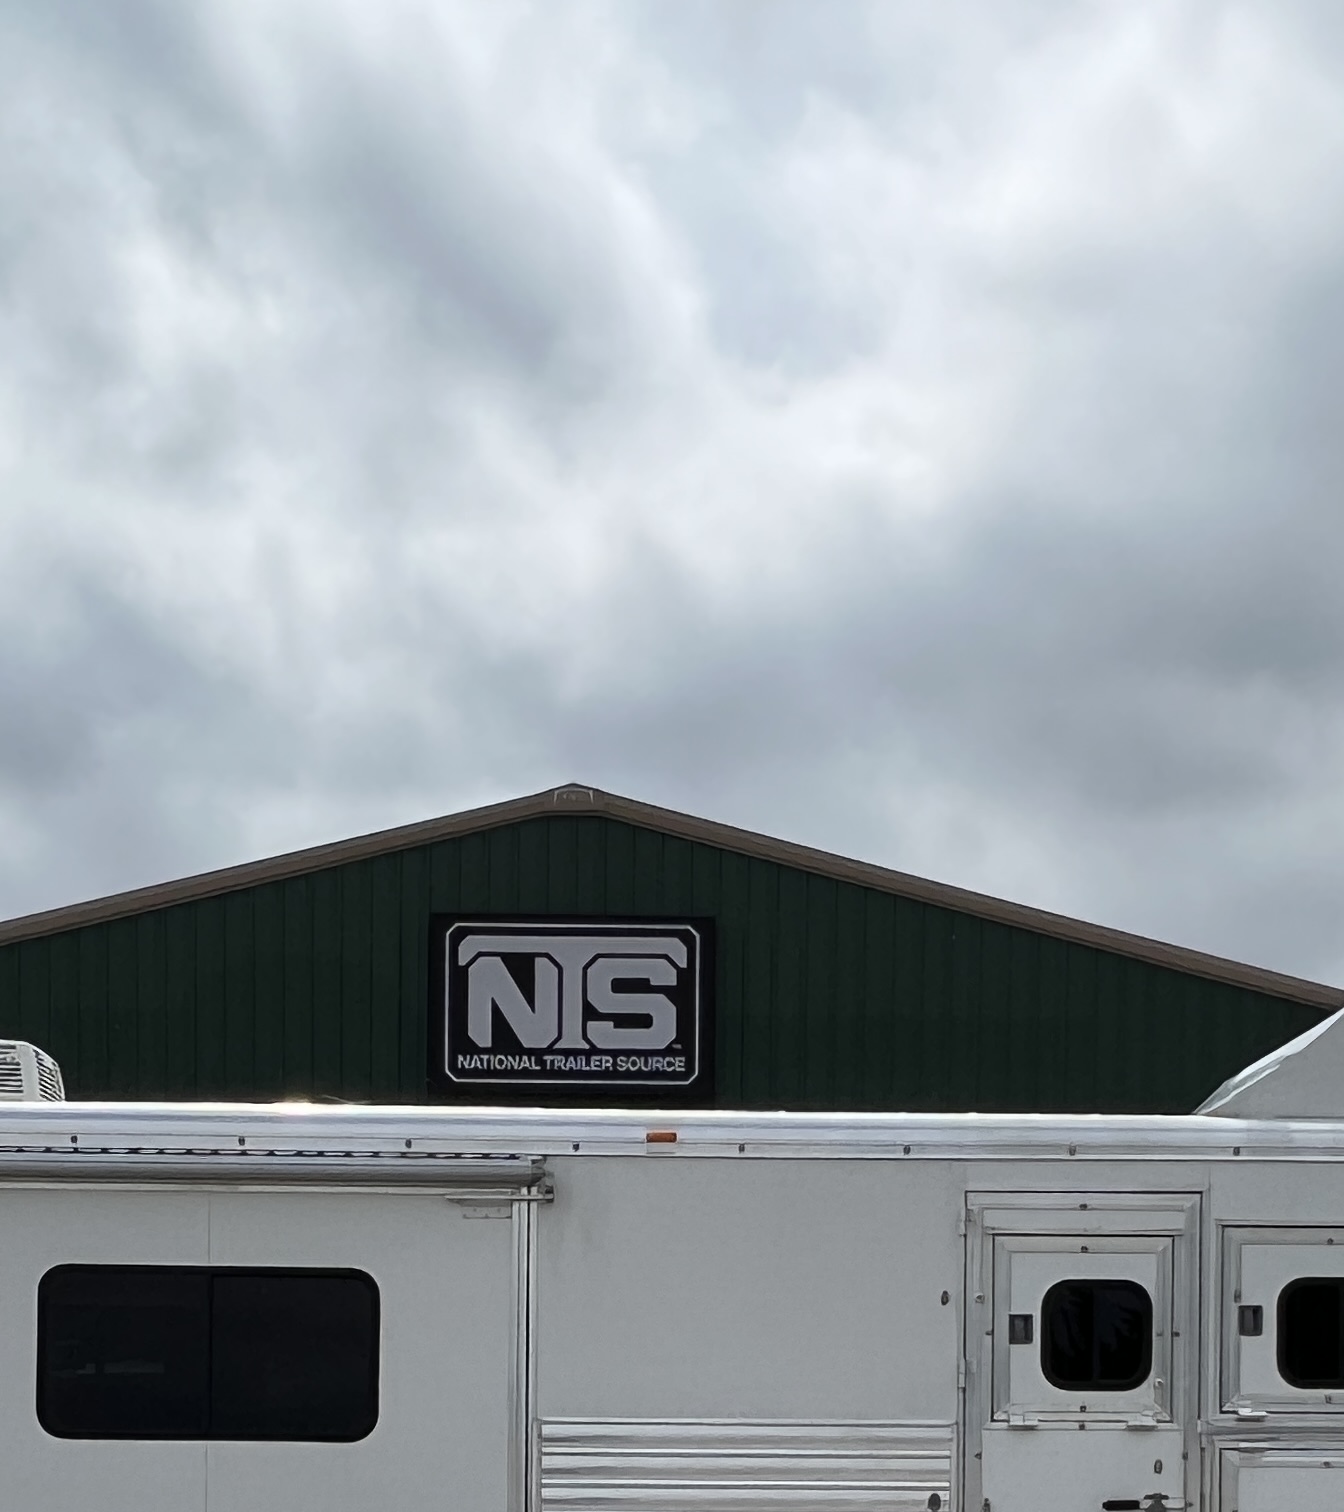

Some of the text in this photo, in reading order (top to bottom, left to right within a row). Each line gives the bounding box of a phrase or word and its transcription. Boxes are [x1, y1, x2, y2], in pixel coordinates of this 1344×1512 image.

[458, 935, 688, 1050] NTS
[457, 1054, 686, 1072] NATIONAL TRAILER SOURCE
